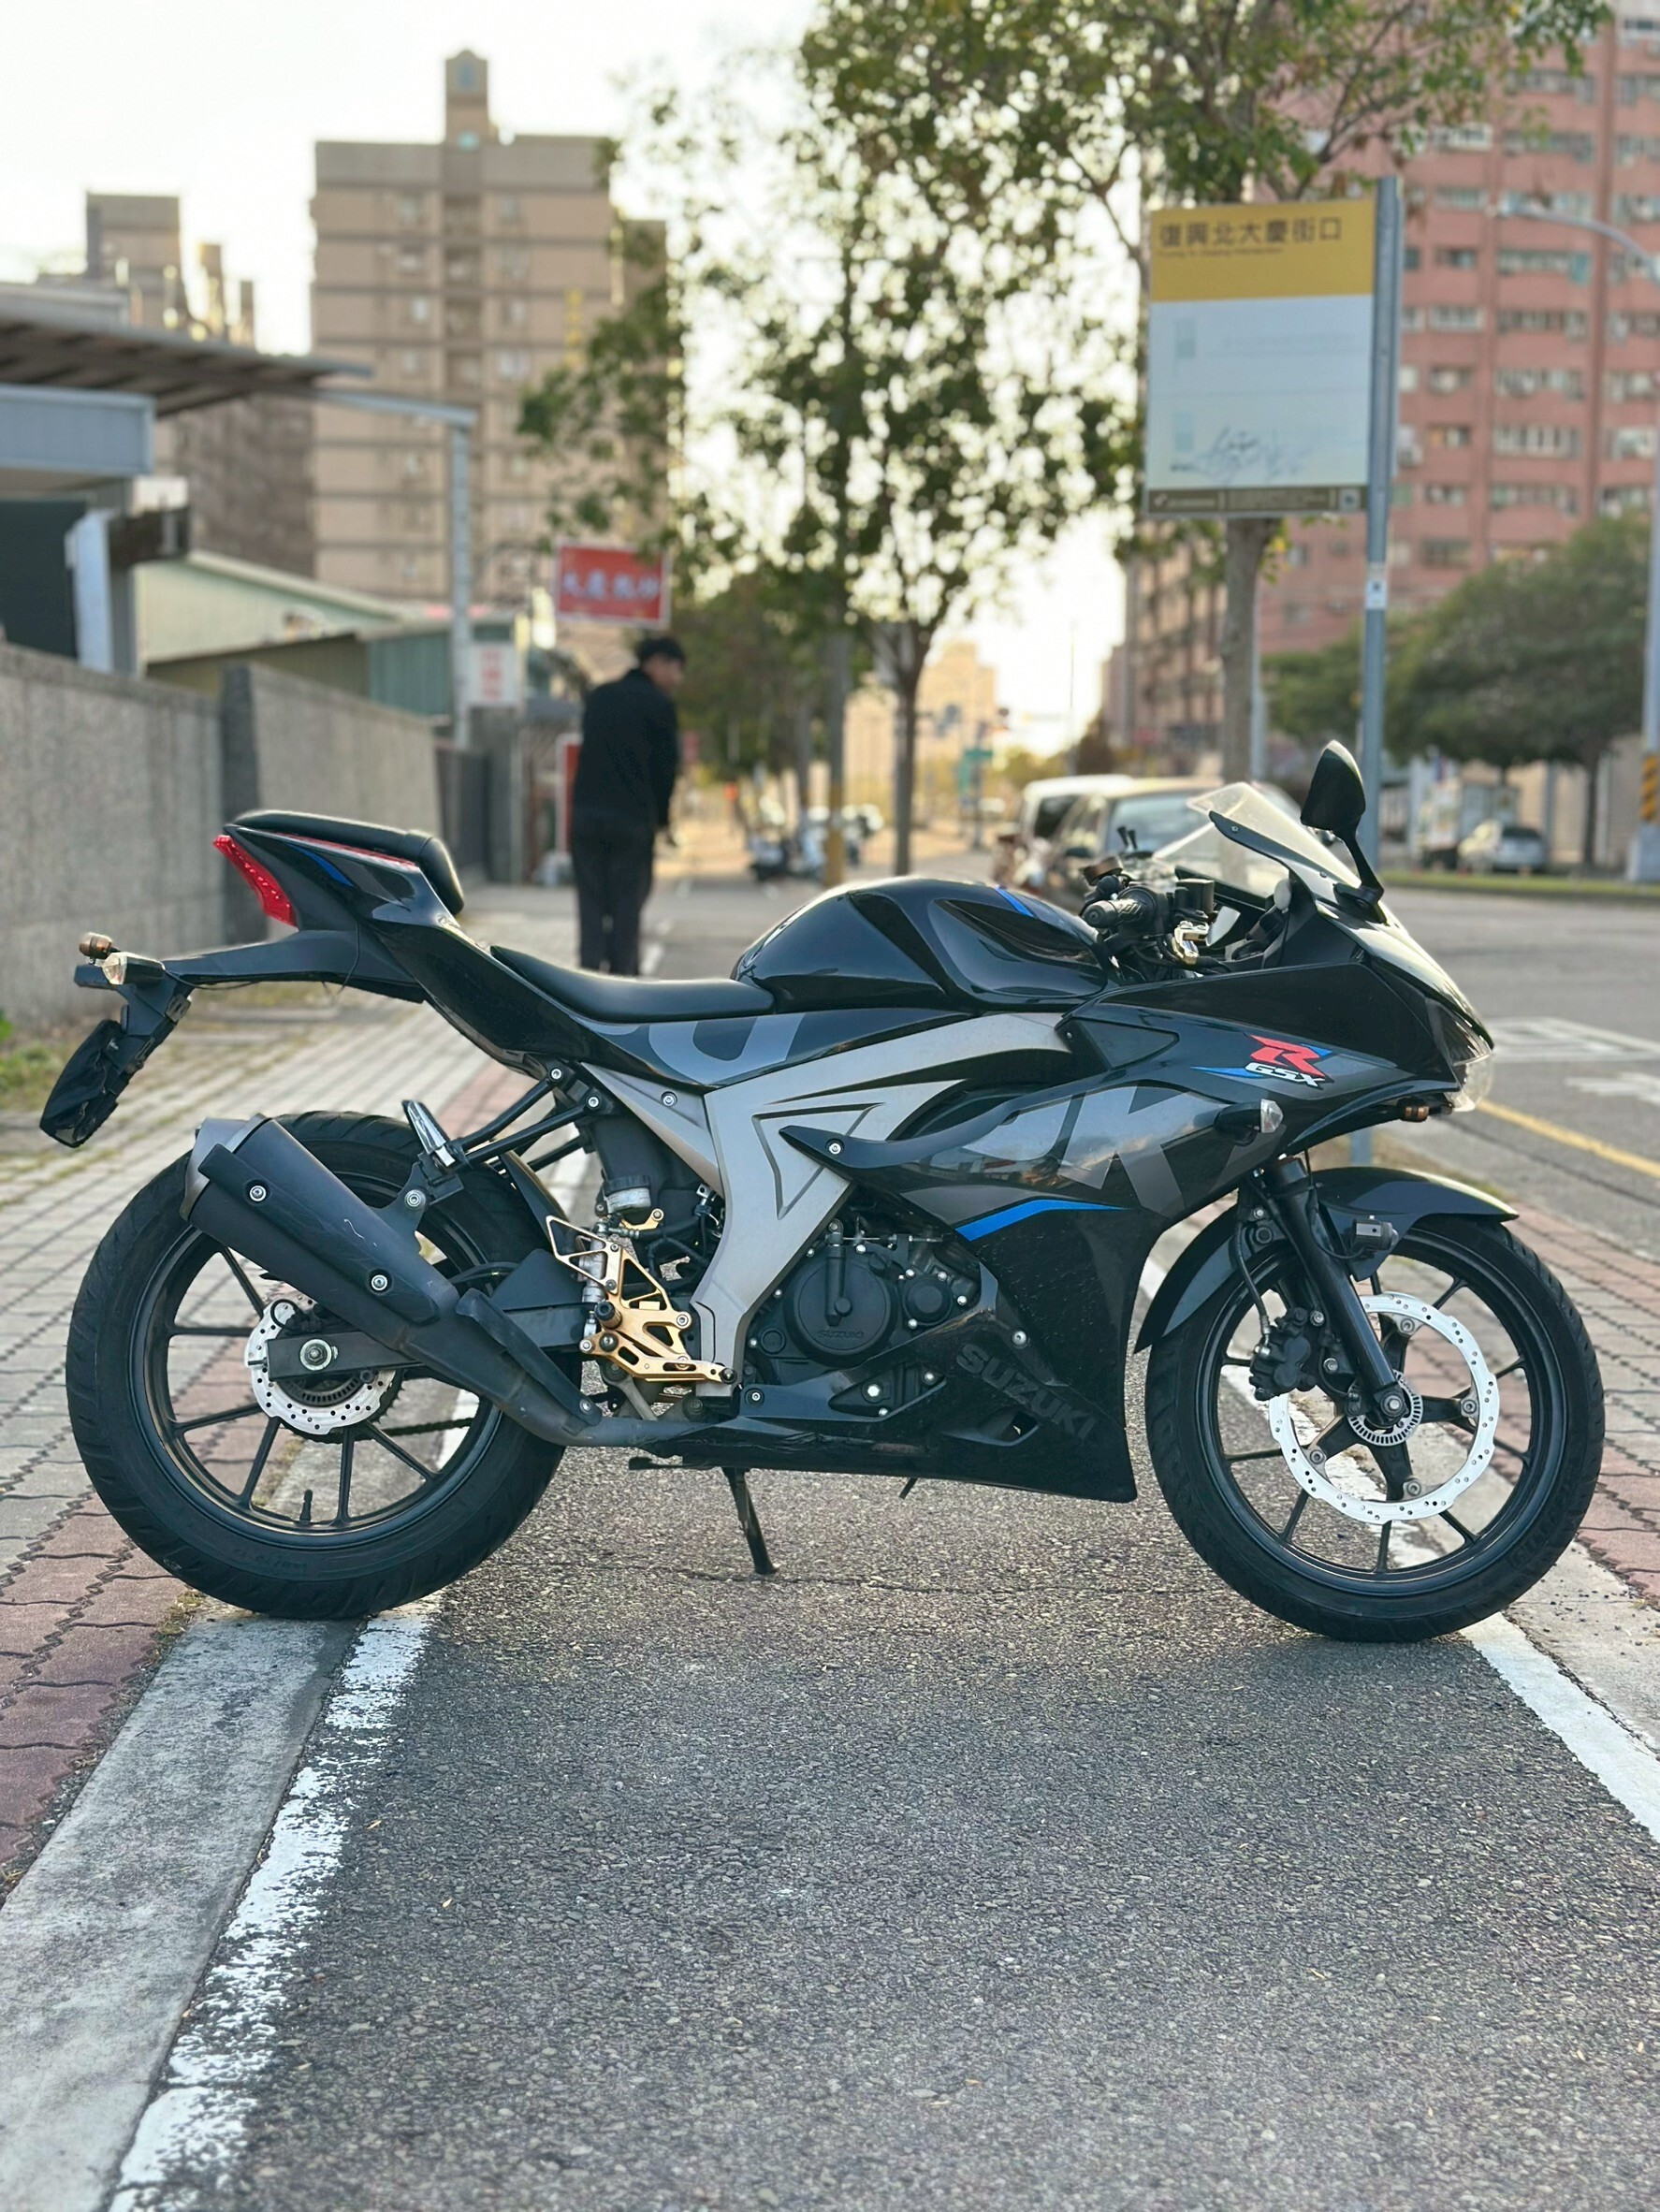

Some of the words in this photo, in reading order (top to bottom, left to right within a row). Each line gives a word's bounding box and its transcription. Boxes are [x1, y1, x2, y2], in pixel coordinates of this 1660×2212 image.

[1250, 1034, 1326, 1078] R
[1245, 1062, 1326, 1087] GSX
[817, 1329, 865, 1340] SUZUKI
[955, 1343, 1099, 1440] SUZUKI
